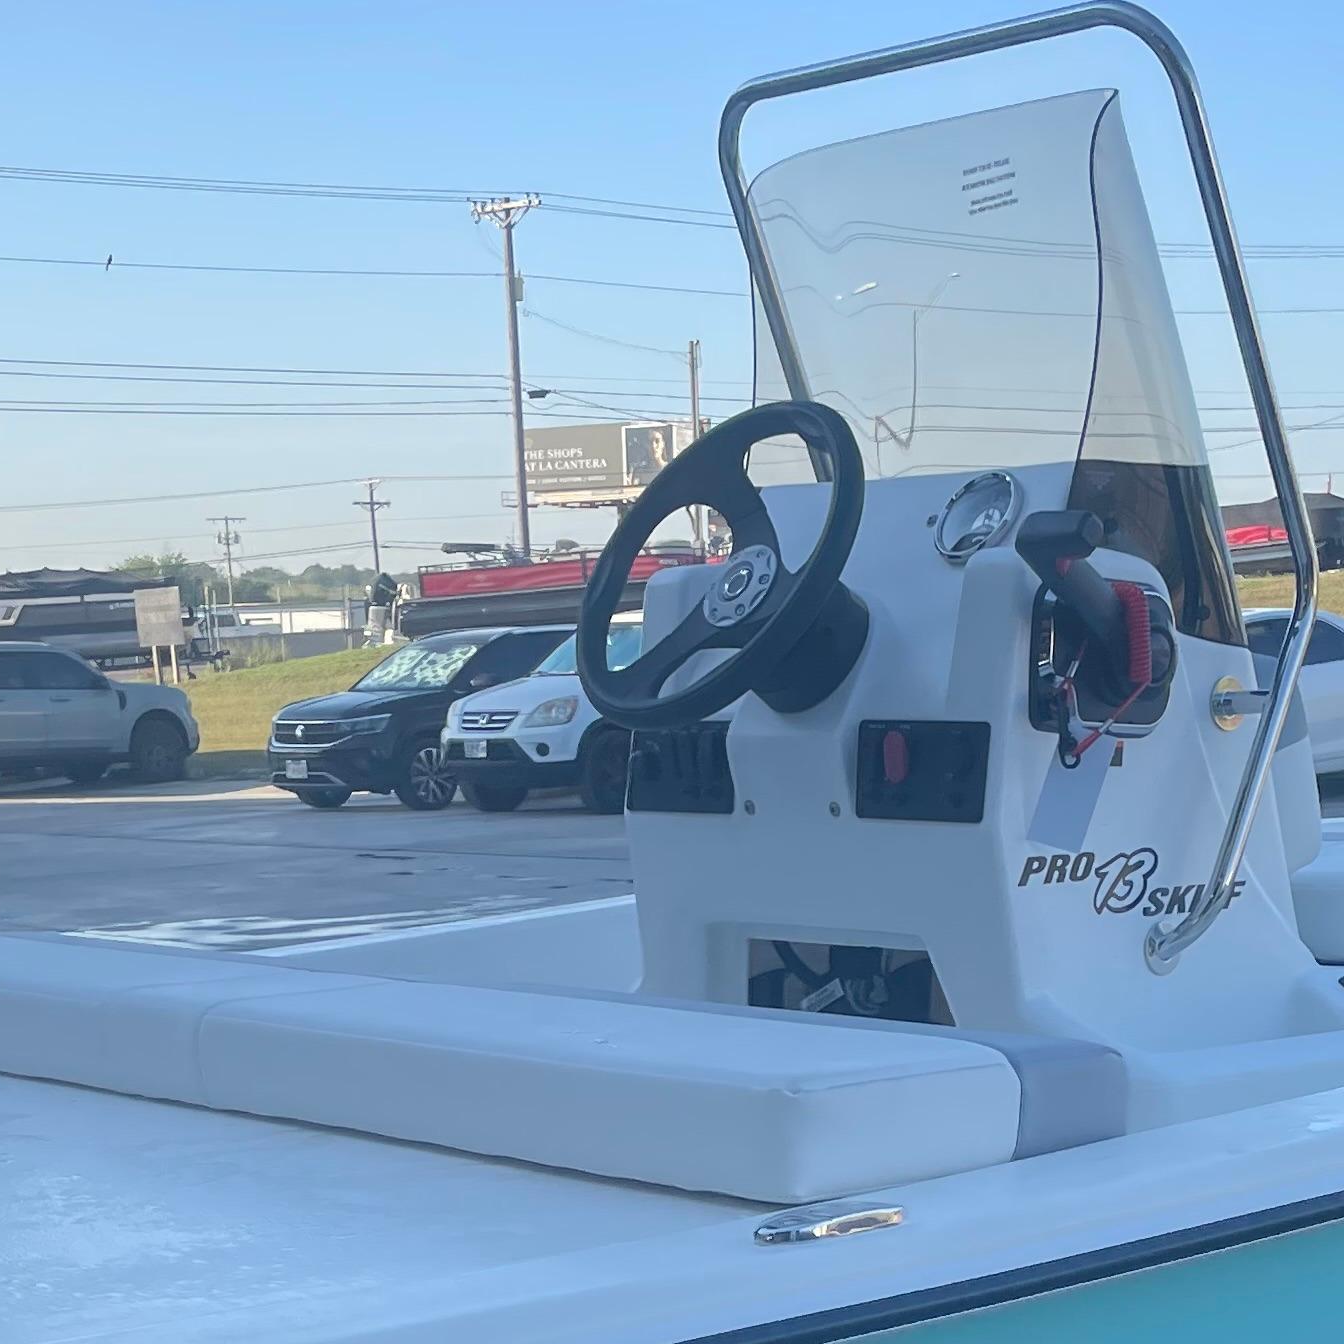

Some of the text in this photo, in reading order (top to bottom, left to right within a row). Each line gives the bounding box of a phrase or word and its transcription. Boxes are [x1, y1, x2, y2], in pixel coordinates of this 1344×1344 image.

[547, 447, 583, 459] SHOPS
[538, 461, 553, 472] LA
[555, 458, 608, 471] CANTERA
[1018, 847, 1247, 917] PRO 13 SKIF
